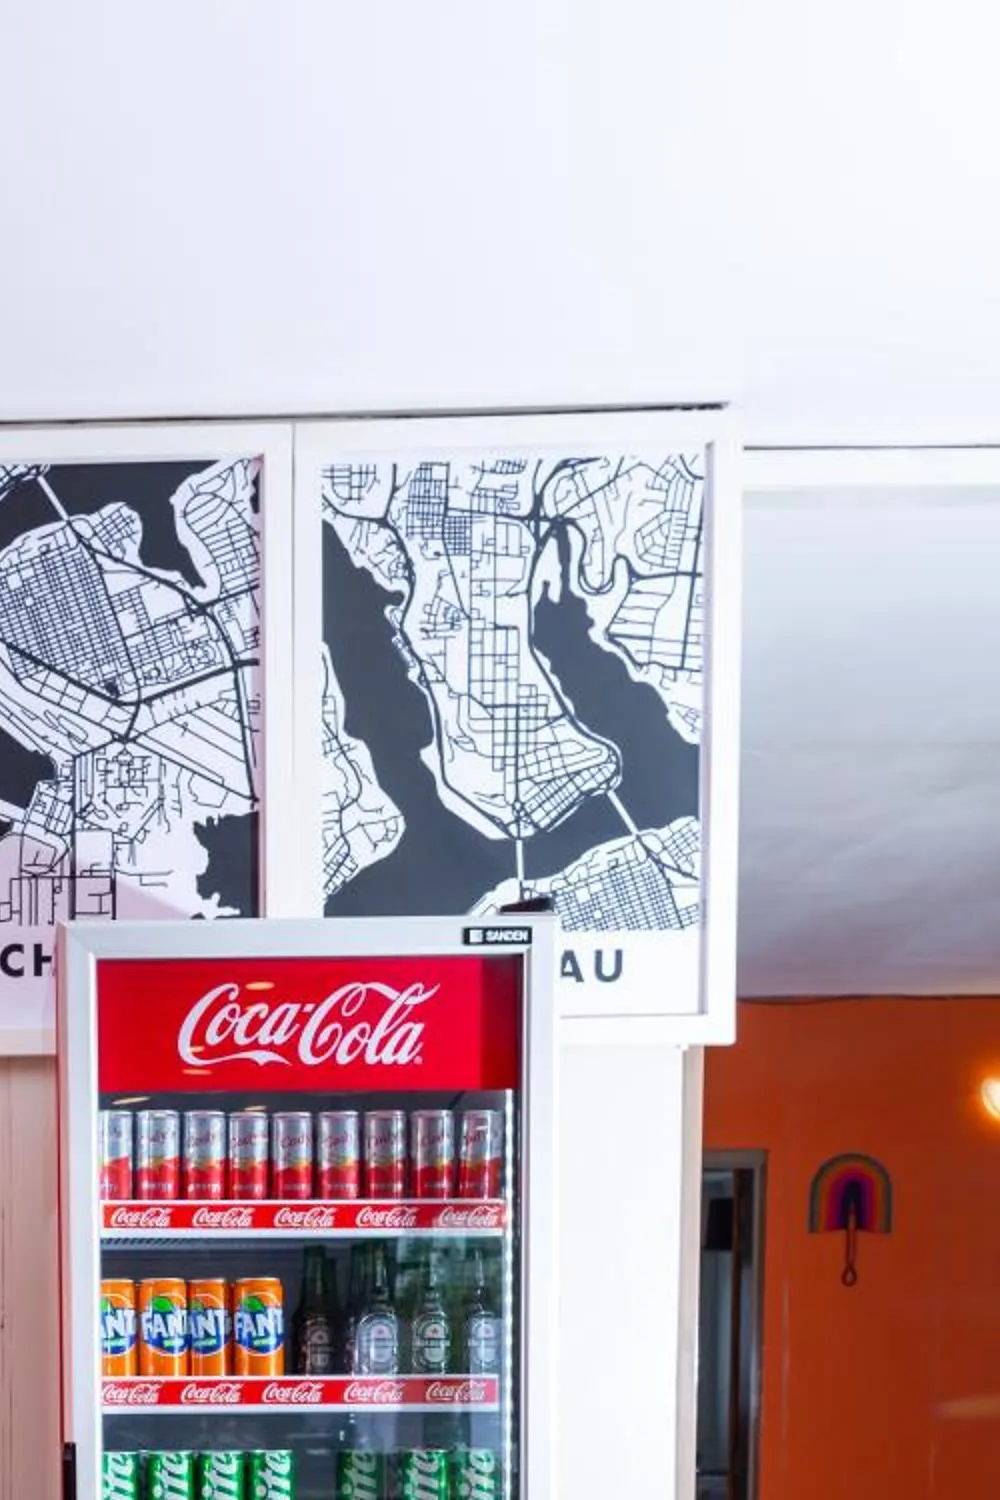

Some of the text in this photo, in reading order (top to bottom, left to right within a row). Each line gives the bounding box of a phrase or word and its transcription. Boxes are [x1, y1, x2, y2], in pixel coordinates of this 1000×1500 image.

[561, 949, 624, 982] AU
[177, 981, 441, 1067] Coca-Cola
[110, 1206, 500, 1227] Coca-Cola Coca-Cola Coca-Cola Coca-Cola Coca-Cola
[180, 1383, 244, 1404] Coca-Cola
[262, 1382, 325, 1404] Coca-Cola
[343, 1382, 405, 1404] Coca-Cola
[425, 1381, 486, 1403] Coca-Cola
